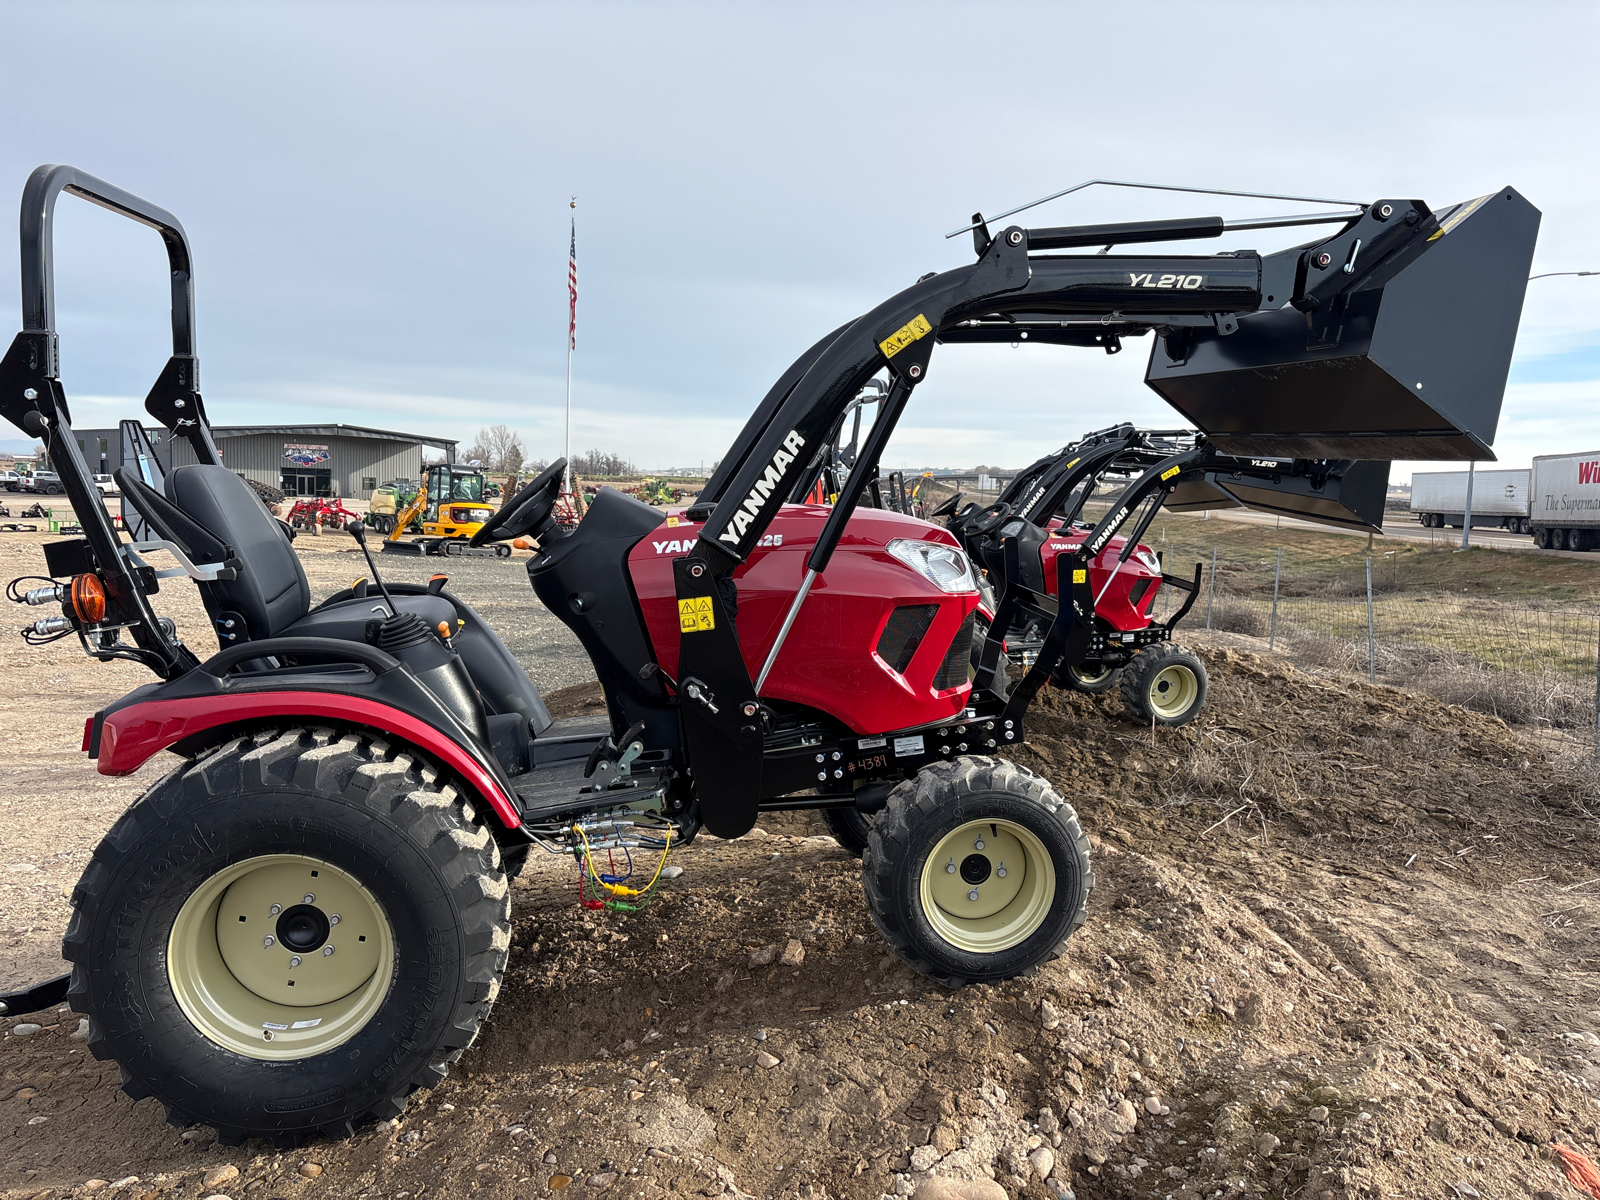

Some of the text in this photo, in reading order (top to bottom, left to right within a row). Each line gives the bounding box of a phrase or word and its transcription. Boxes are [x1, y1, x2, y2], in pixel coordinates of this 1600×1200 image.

[1128, 273, 1203, 289] YL210
[1251, 459, 1278, 468] YL210
[719, 429, 806, 545] YANMAR
[1019, 486, 1046, 518] YANMAR
[1545, 494, 1559, 510] The
[470, 509, 490, 517] JCB
[1091, 506, 1129, 551] YANMAR
[652, 539, 698, 554] YAN
